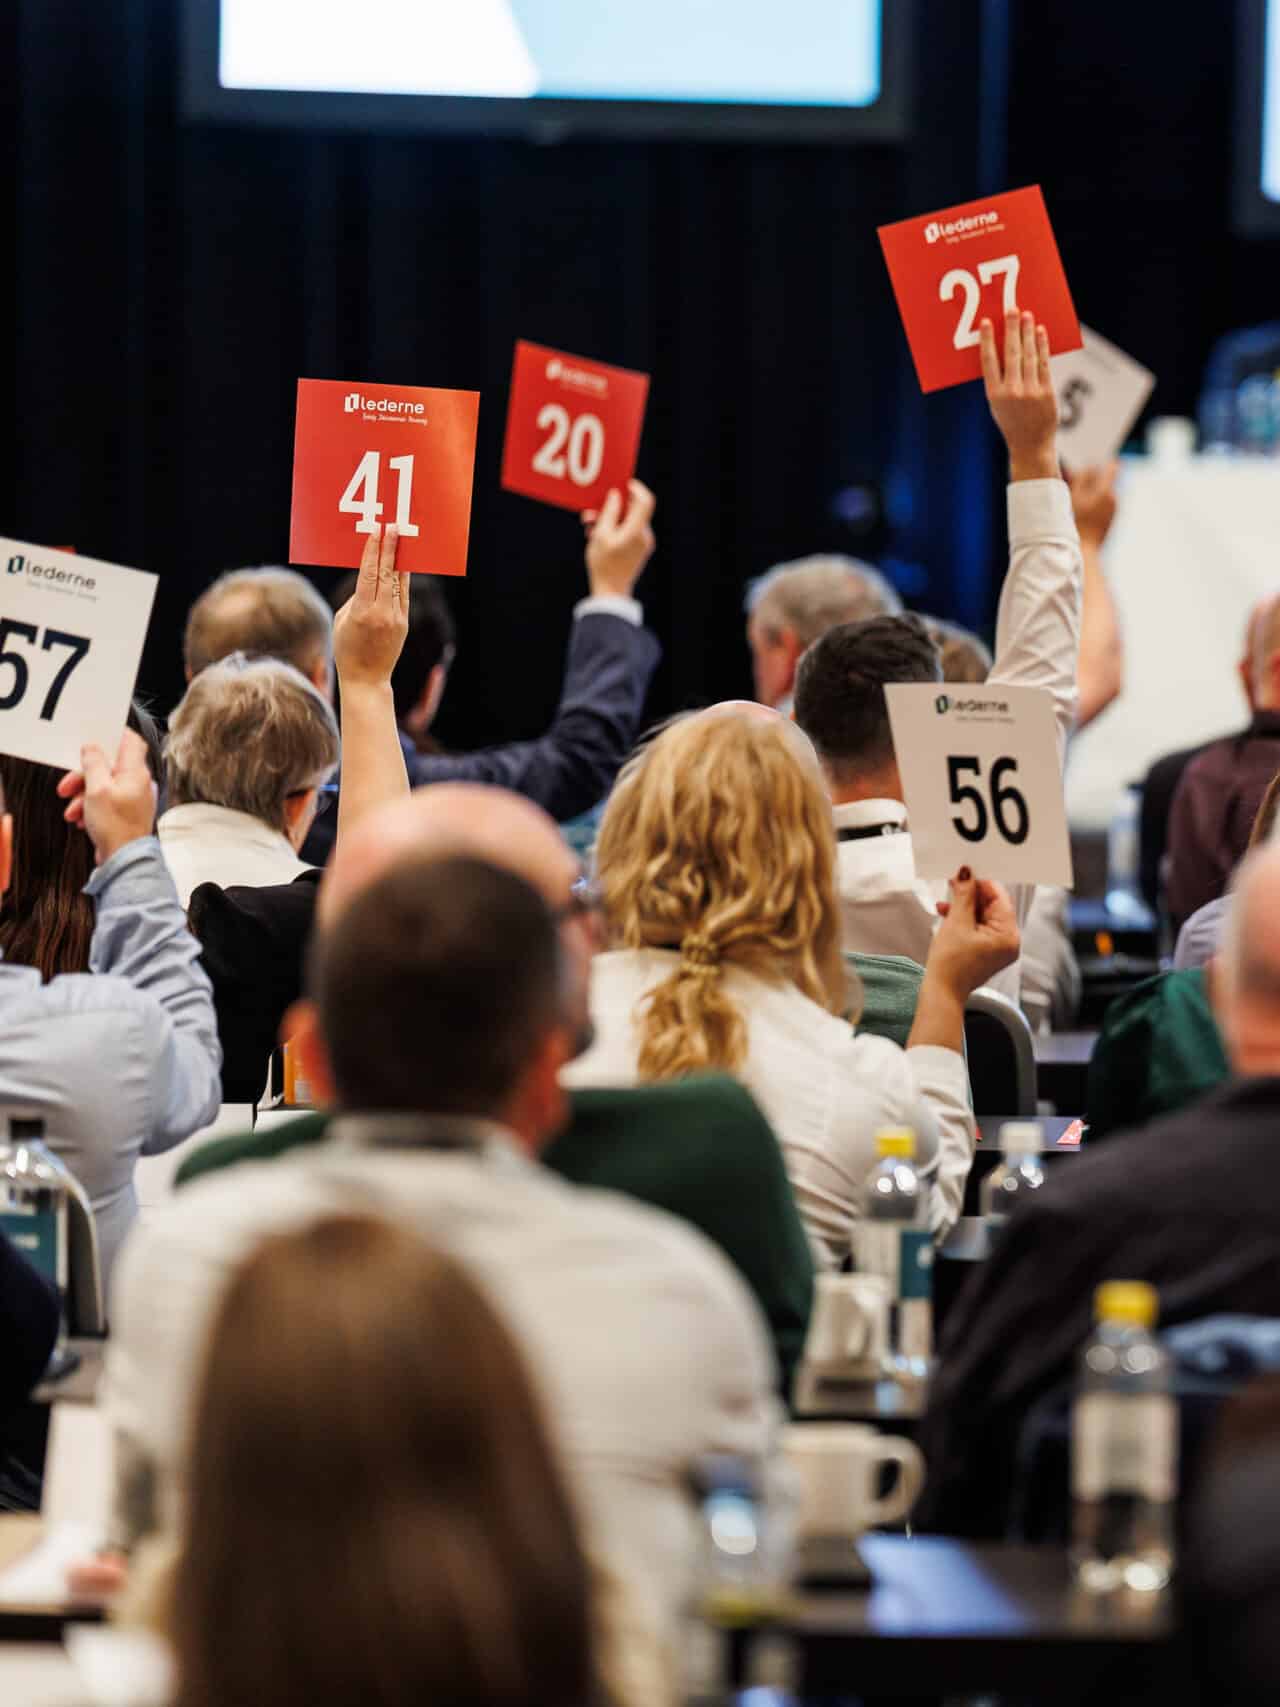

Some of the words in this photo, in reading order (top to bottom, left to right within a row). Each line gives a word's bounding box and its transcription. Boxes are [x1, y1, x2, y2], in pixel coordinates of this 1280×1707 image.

[939, 254, 1021, 350] 27
[361, 396, 425, 414] lederne
[532, 402, 605, 487] 20
[339, 451, 419, 537] 41
[26, 560, 97, 590] lederne
[0, 617, 92, 721] 57
[947, 756, 1030, 845] 56
